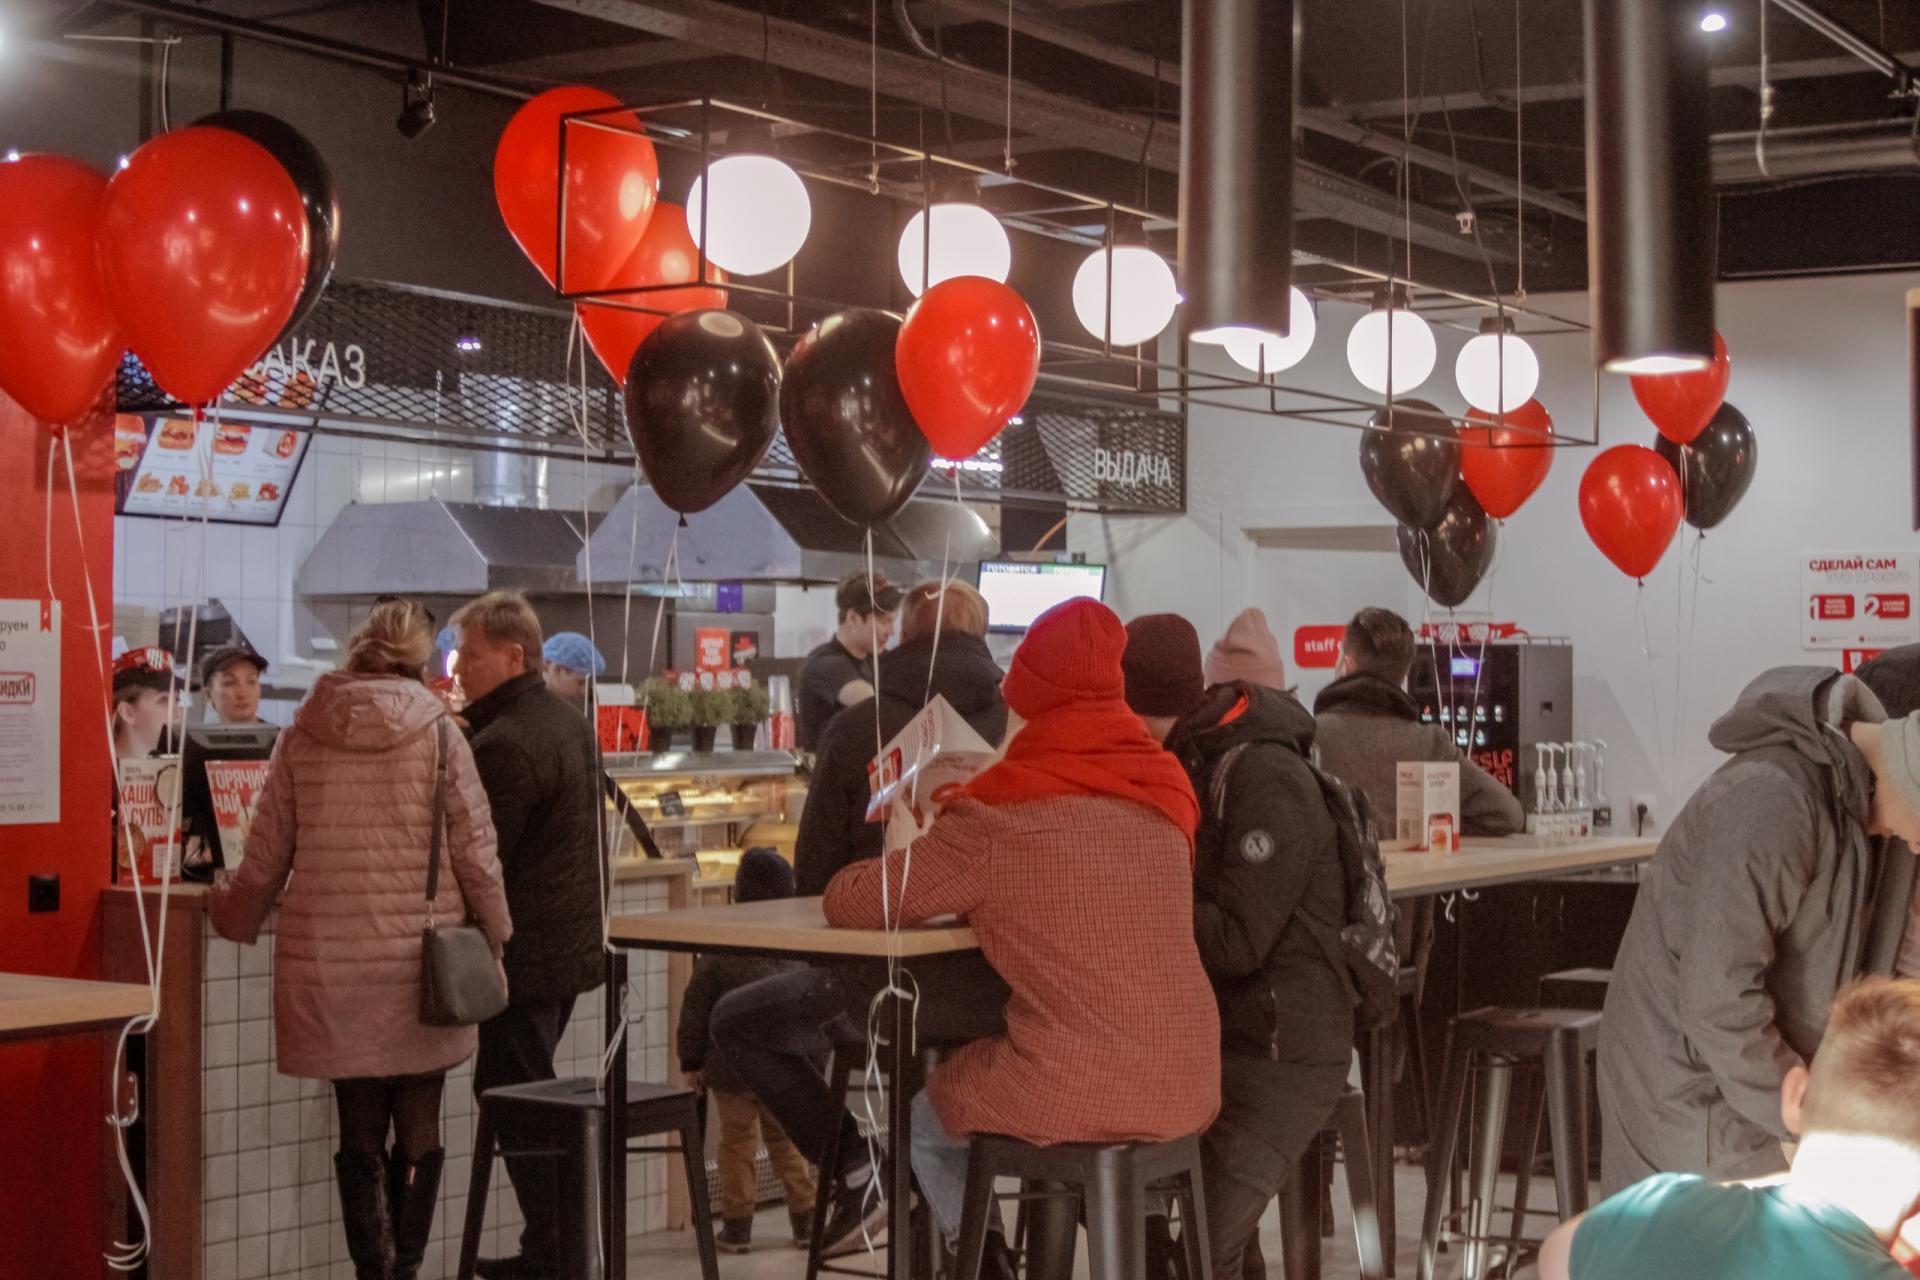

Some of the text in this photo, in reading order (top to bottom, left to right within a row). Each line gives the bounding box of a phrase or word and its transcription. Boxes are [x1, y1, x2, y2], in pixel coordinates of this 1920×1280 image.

[243, 337, 366, 389] АКАЗ
[1094, 448, 1173, 488] ВЫДАЧА
[1809, 555, 1896, 571] СДЕЛАЙ САМ
[1864, 596, 1880, 618] 2
[1304, 638, 1335, 652] staff
[213, 788, 241, 814] ЧАЙ
